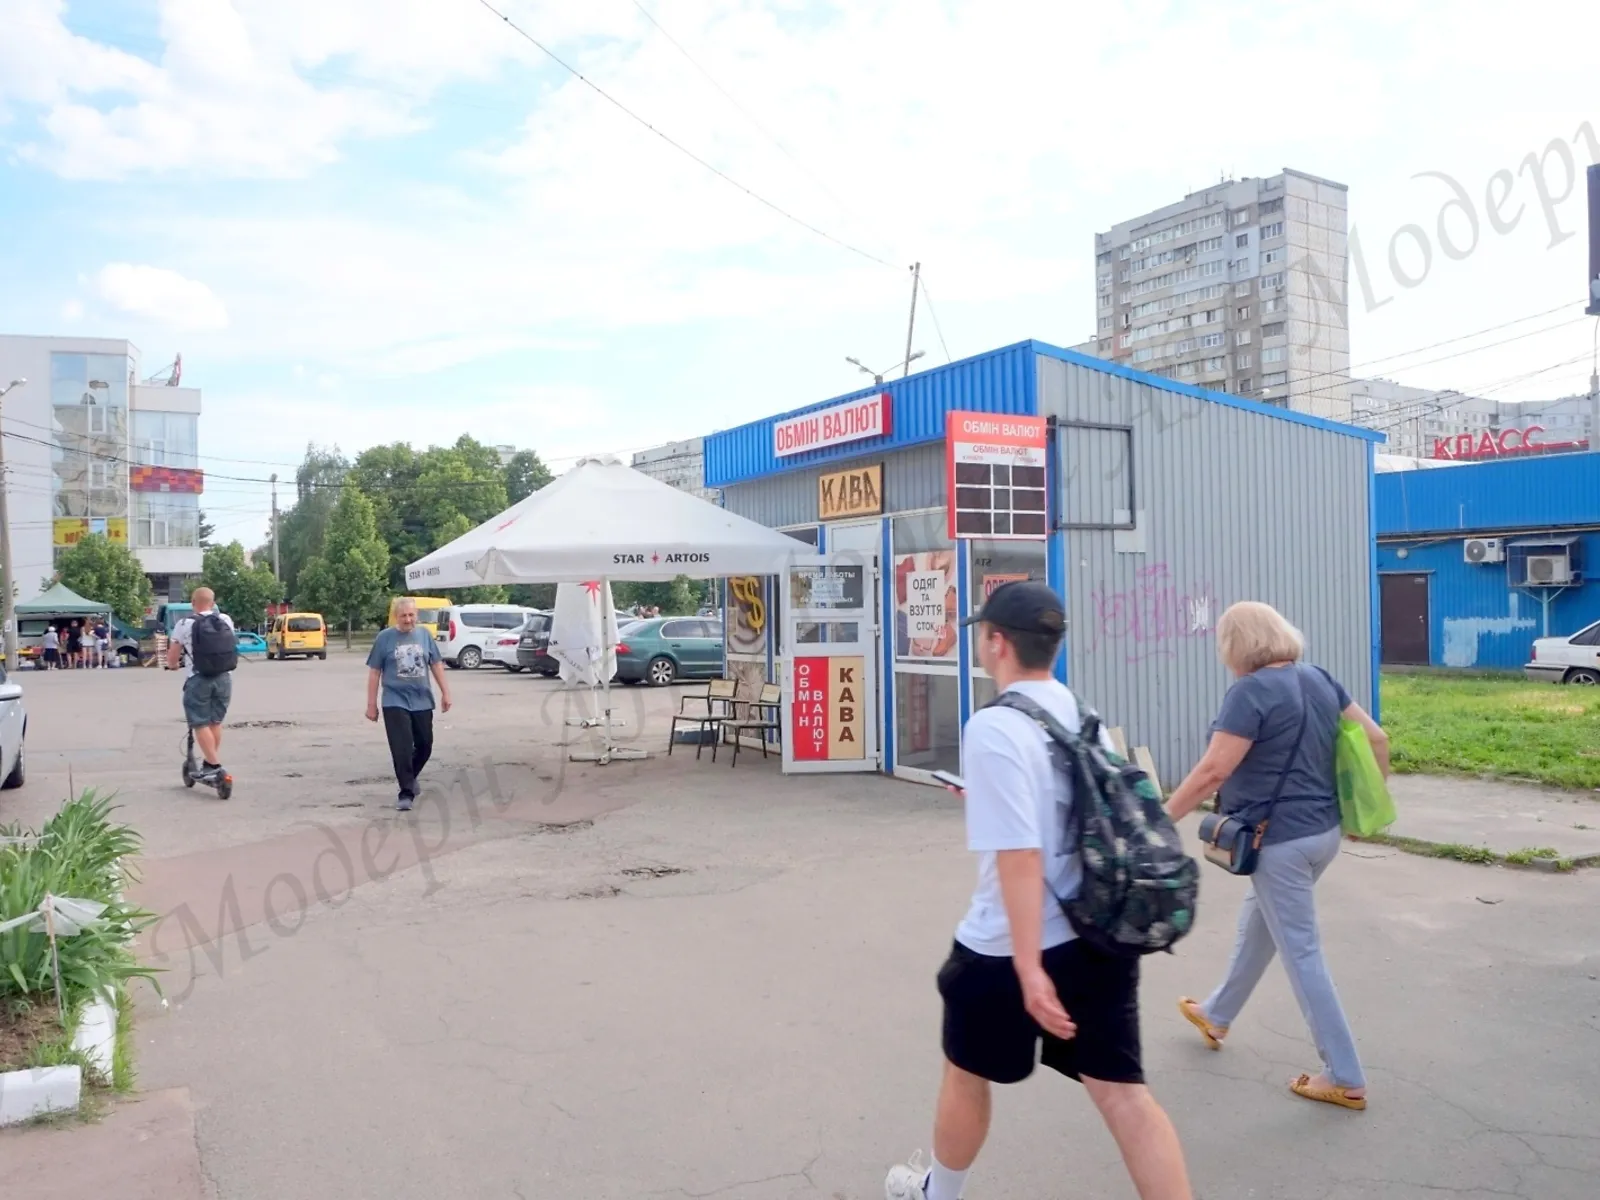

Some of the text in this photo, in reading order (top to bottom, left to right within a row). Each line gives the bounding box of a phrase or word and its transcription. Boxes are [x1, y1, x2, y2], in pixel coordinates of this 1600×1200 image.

[776, 402, 879, 452] ОБМІН ВАЛЮТ
[963, 420, 1041, 438] ОБМІН ВАЛЮТ
[973, 444, 1028, 456] ОБМІН ВАЛЮТ
[821, 470, 879, 515] КАВА
[613, 552, 710, 564] STAR ARTOIS
[912, 577, 938, 591] ОДЯГ
[921, 593, 930, 601] ТА
[909, 604, 943, 617] ВЗУТТЯ
[916, 621, 934, 631] СТОК
[798, 664, 810, 727] ОБМІН
[838, 667, 855, 742] КАВА
[812, 690, 824, 753] ВАЛЮТ
